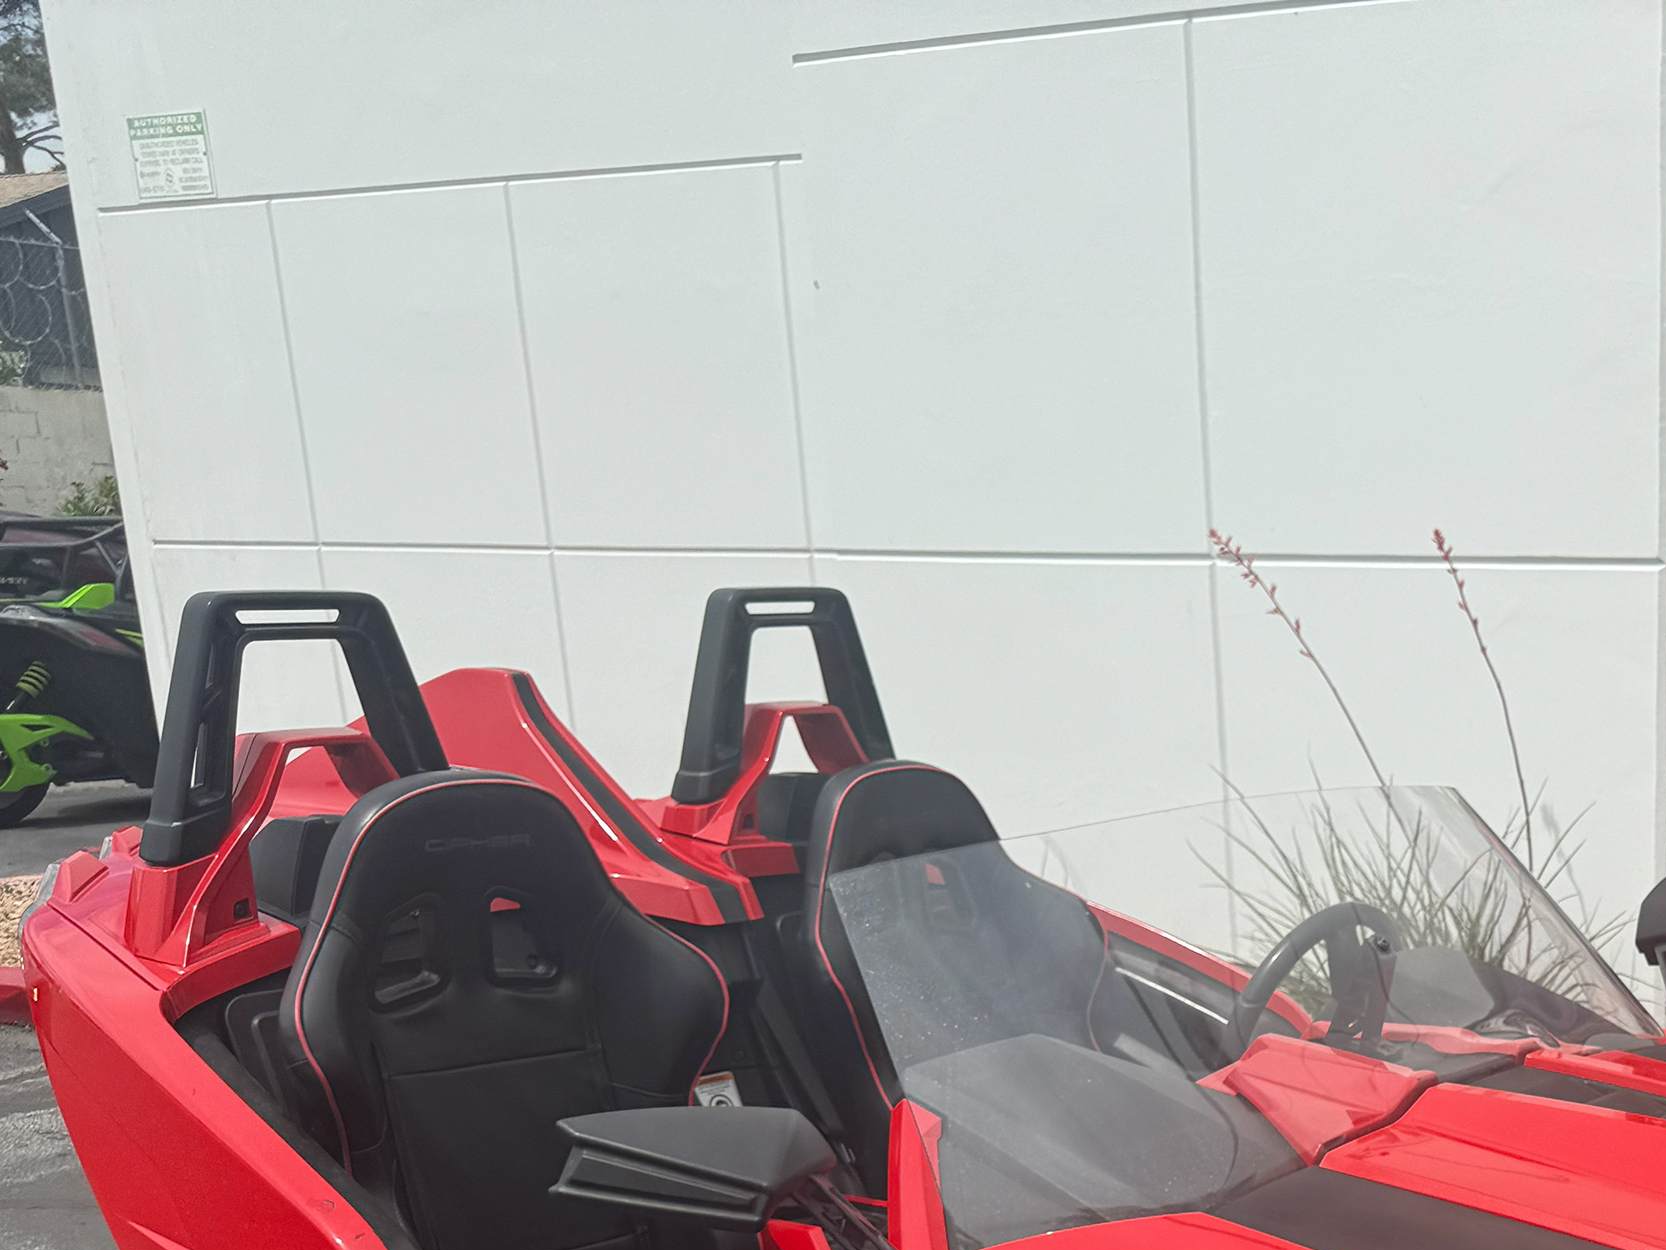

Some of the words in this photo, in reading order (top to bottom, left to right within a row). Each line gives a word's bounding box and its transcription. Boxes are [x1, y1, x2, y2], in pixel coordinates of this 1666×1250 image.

[133, 114, 197, 127] AUTHORIZED
[129, 125, 174, 136] PARKING
[176, 123, 203, 134] ONLY
